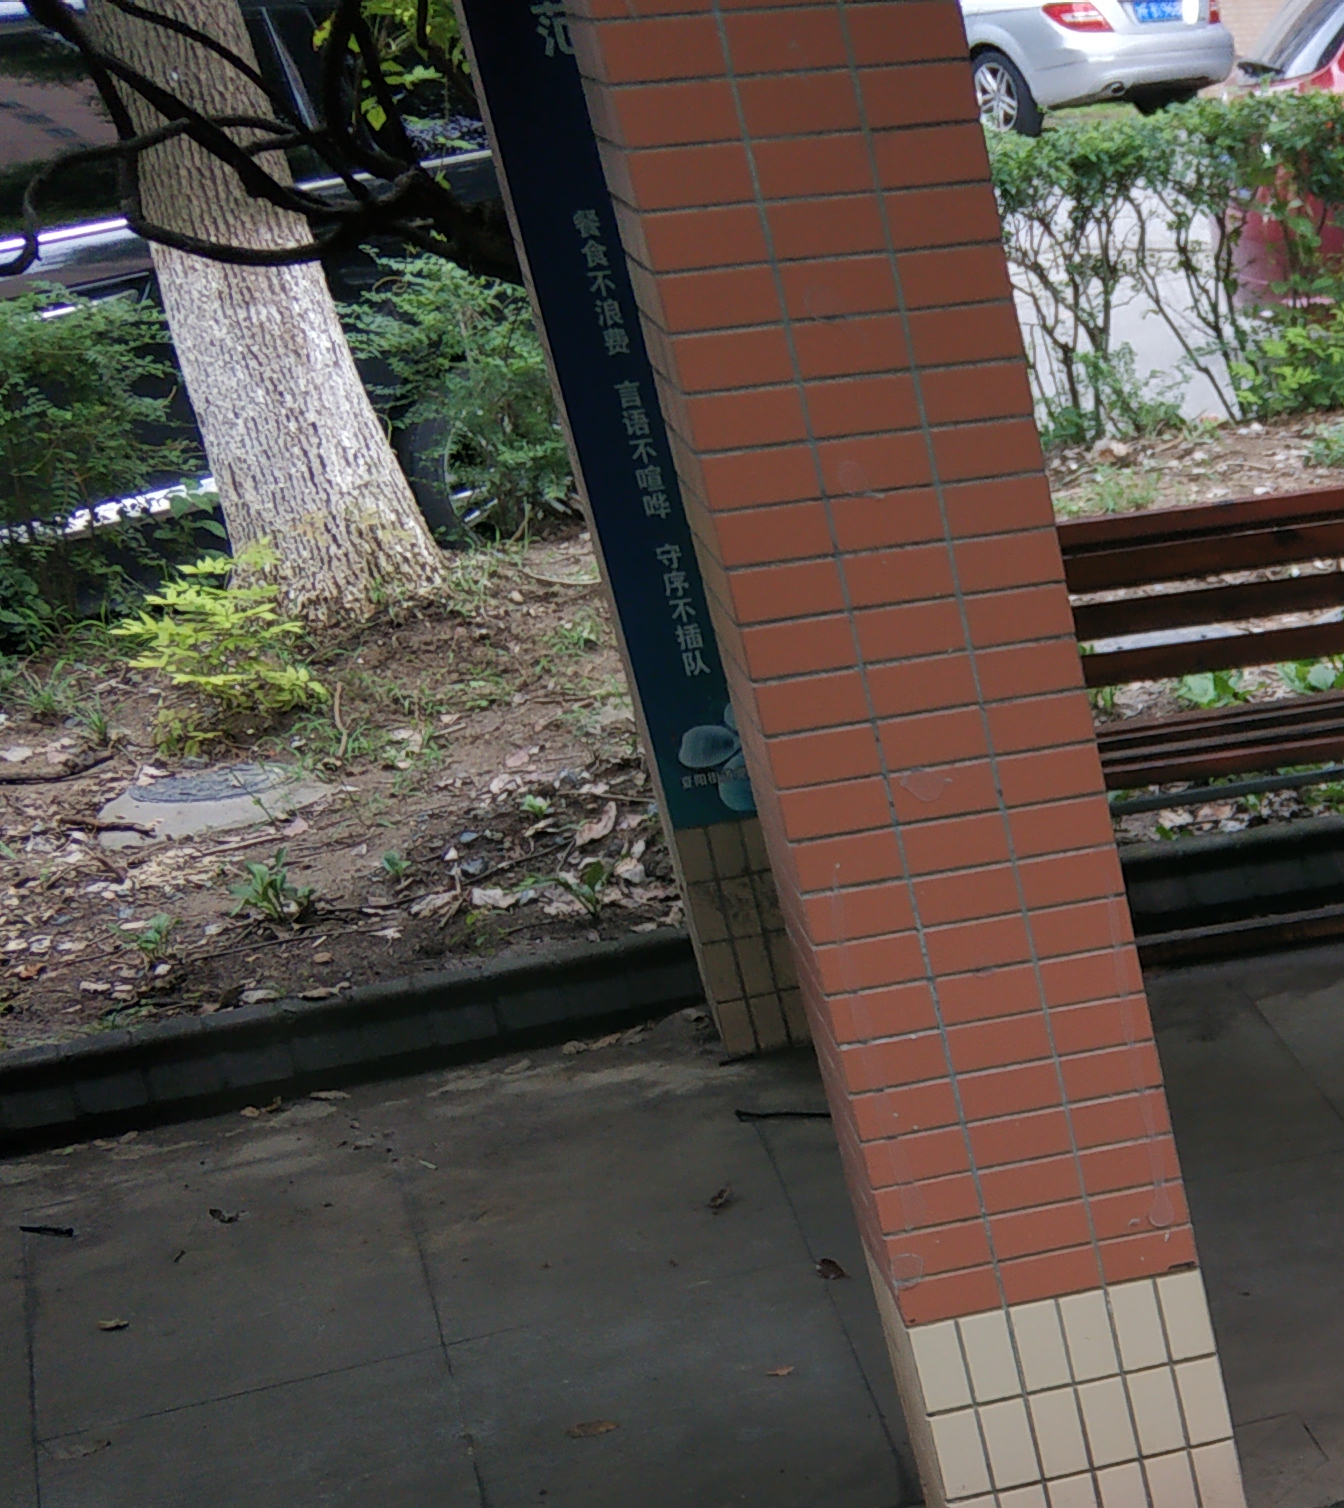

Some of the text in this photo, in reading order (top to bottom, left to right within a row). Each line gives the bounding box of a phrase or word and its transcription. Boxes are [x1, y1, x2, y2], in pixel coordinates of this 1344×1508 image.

[573, 209, 711, 677] 餐食不浪费 言语不喧哗 守序不插队
